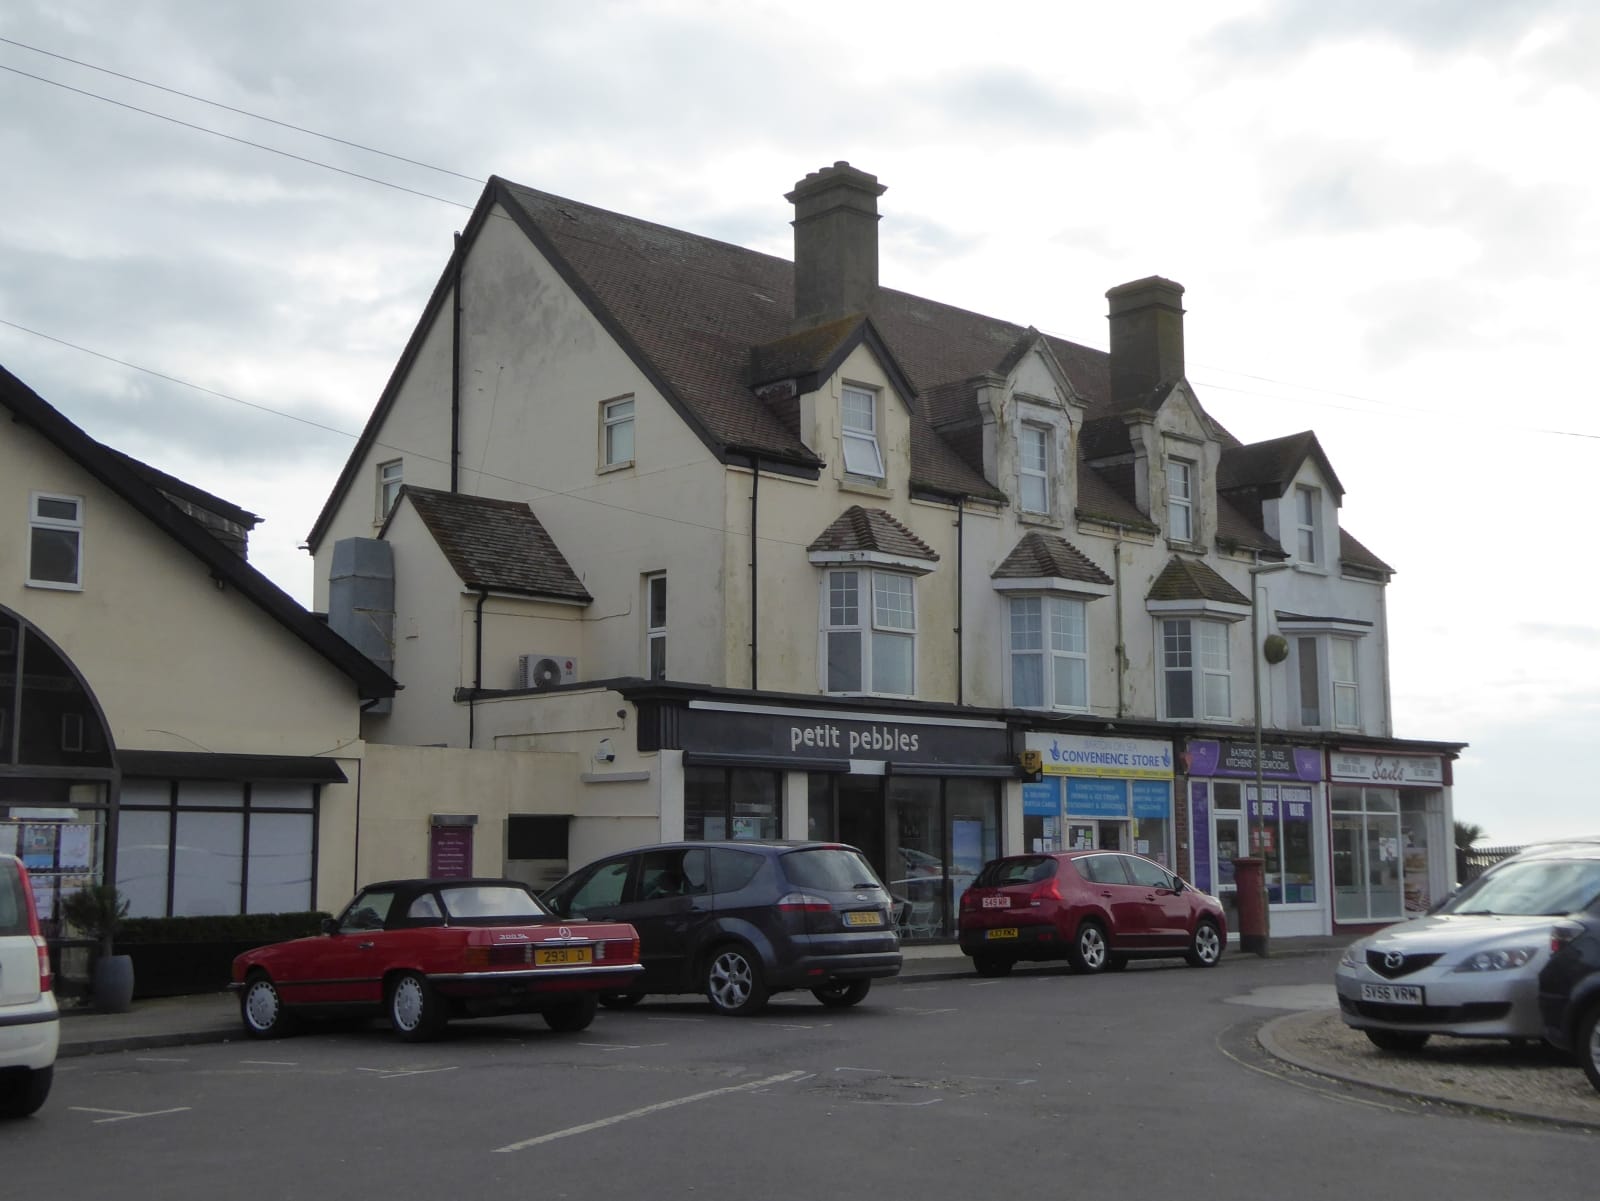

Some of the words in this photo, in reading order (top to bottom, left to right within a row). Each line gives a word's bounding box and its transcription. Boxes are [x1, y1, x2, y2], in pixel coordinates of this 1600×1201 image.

[791, 724, 840, 752] petit
[849, 725, 919, 755] pebbles
[1061, 750, 1130, 766] CONVENIENCE
[1131, 754, 1160, 767] STORE
[543, 951, 569, 963] 2931
